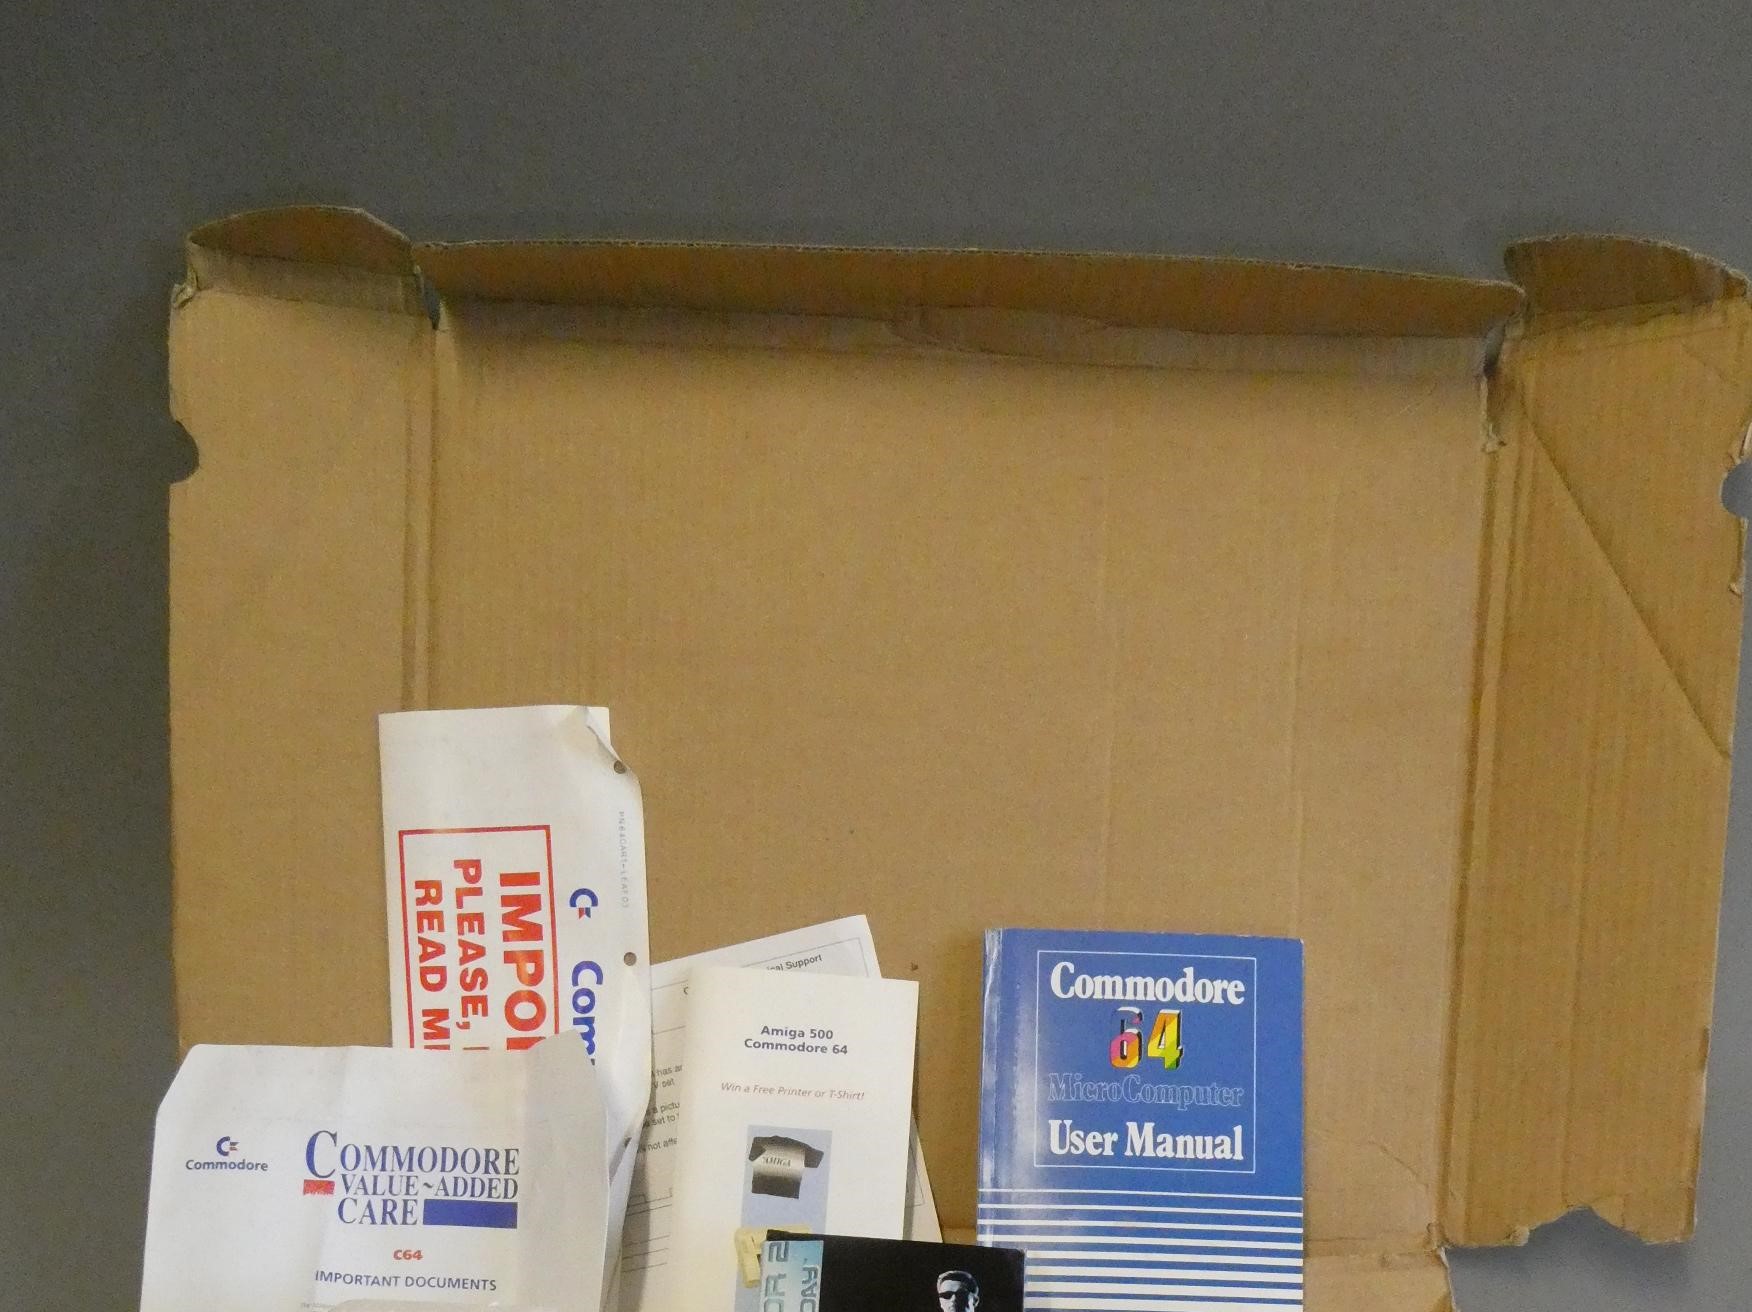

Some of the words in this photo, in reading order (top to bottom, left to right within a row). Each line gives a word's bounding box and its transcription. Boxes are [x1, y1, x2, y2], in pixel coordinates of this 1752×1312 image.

[415, 880, 447, 993] READ
[453, 859, 489, 1030] PLEASE,
[785, 954, 822, 970] Support
[1050, 961, 1246, 1005] Commodore
[570, 961, 604, 1060] Com
[421, 1008, 451, 1050] M
[760, 1025, 805, 1039] Amiga
[809, 1029, 834, 1040] 500
[1109, 1006, 1184, 1071] 64
[744, 1038, 828, 1054] Commodore
[832, 1045, 848, 1055] 64
[721, 1082, 741, 1093] Win
[753, 1084, 775, 1095] Free
[777, 1086, 812, 1097] Printer
[814, 1090, 826, 1098] or
[829, 1089, 865, 1101] T-Shirt!
[1047, 1072, 1245, 1111] MicroComputer
[305, 1130, 520, 1179] COMMODORE
[1048, 1119, 1119, 1156] User
[1124, 1121, 1244, 1161] Manual
[185, 1159, 269, 1172] Commodore
[337, 1197, 418, 1226] CARE
[393, 1249, 423, 1261] C64
[768, 1241, 790, 1263] 2
[315, 1269, 401, 1288] IMPORTANT
[404, 1275, 497, 1292] DOCUMENTS
